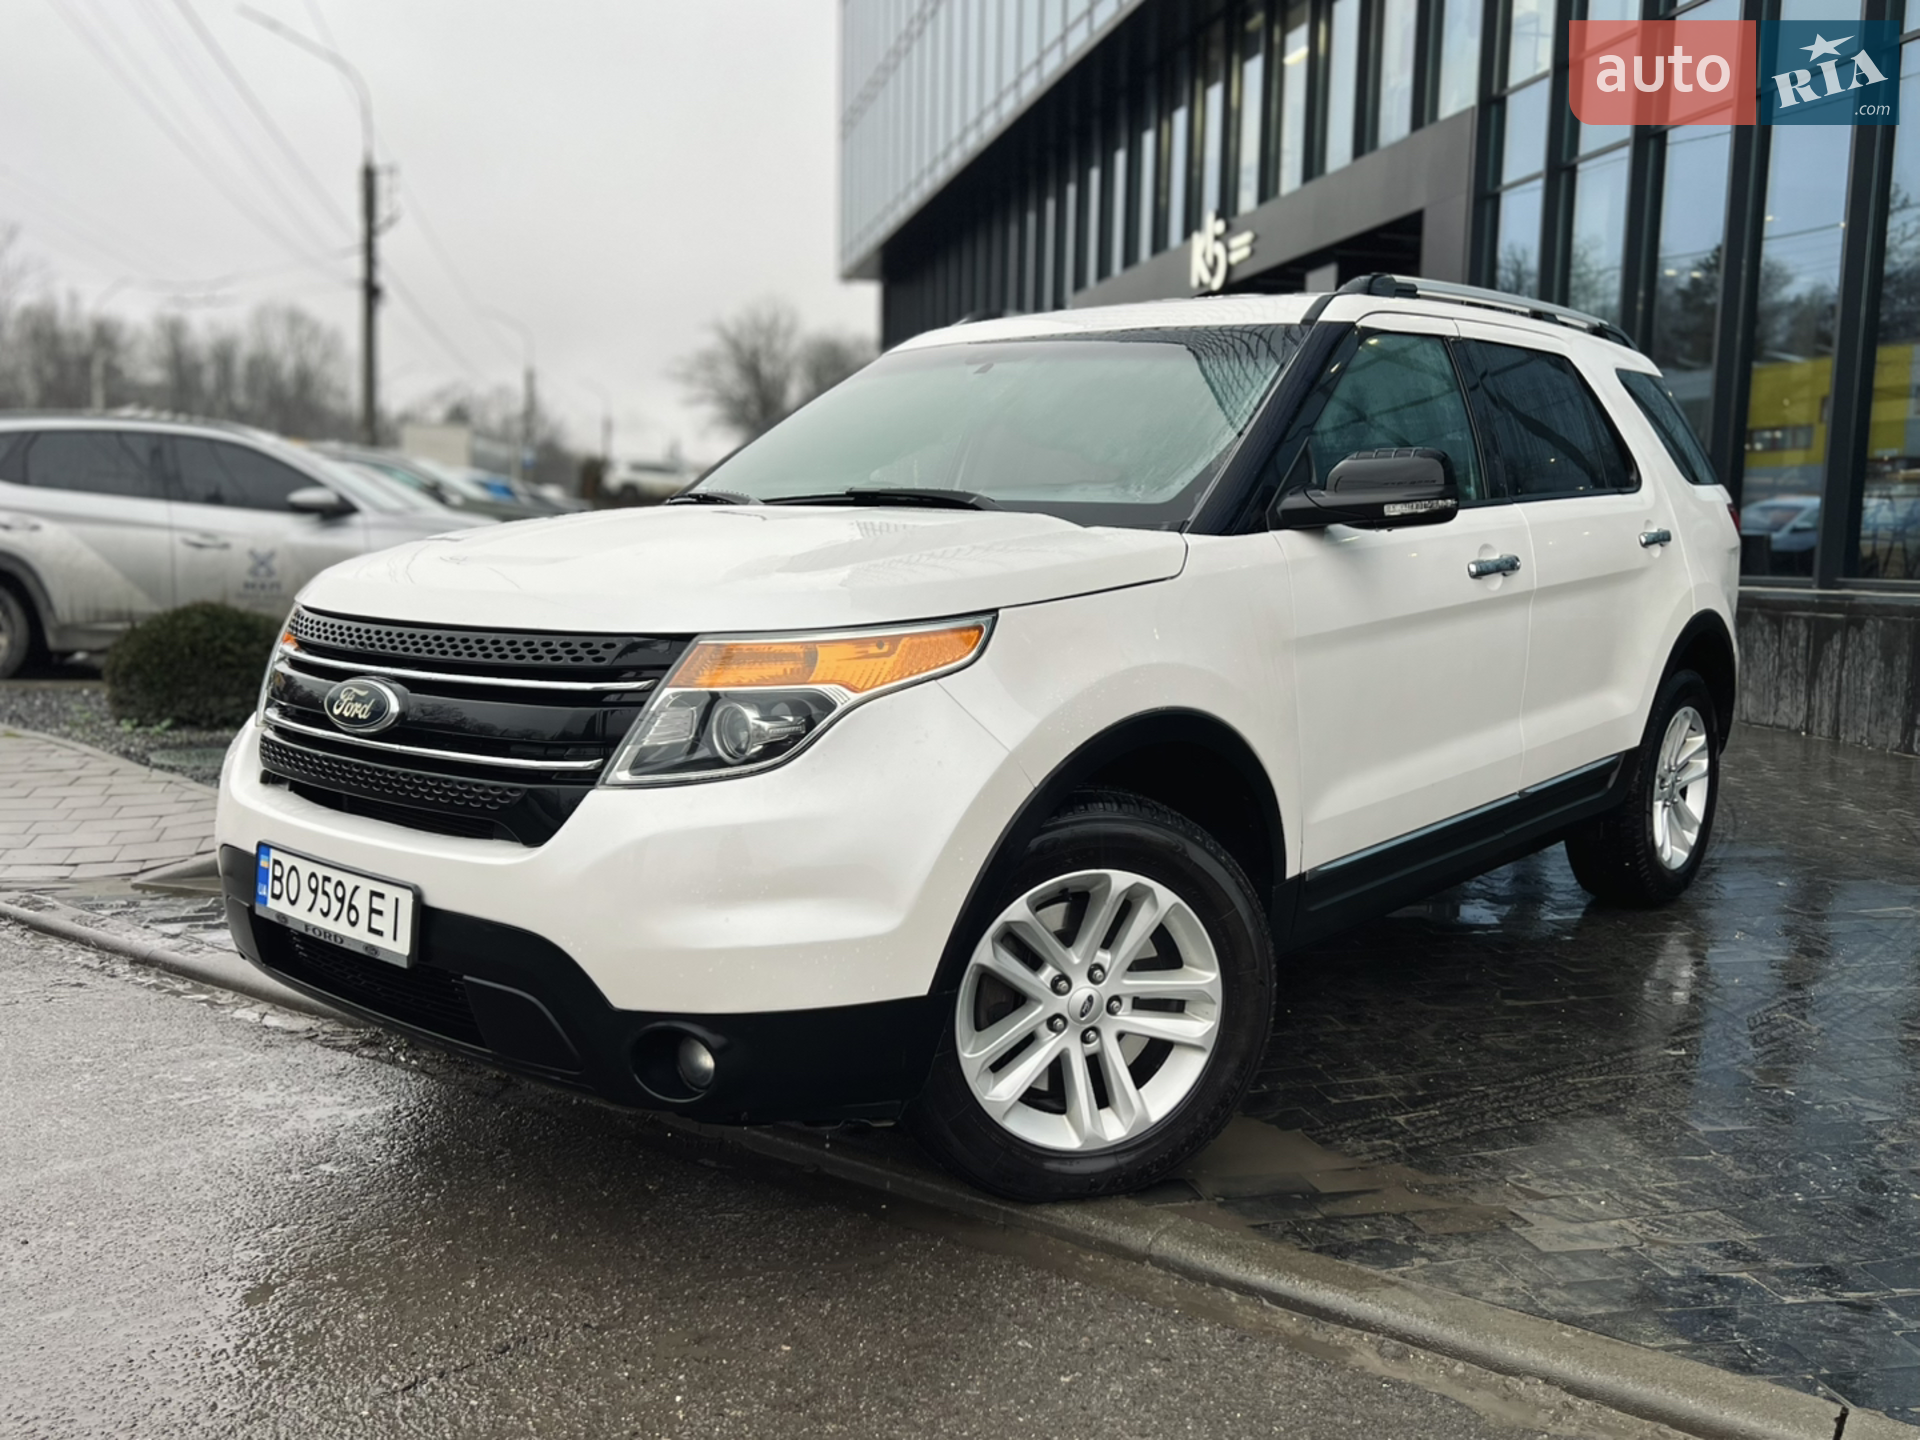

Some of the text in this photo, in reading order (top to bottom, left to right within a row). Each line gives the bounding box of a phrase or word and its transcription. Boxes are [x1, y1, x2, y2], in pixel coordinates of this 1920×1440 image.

[333, 686, 376, 720] Ford
[271, 858, 400, 943] BO 9596 EI
[304, 927, 344, 946] FORD
